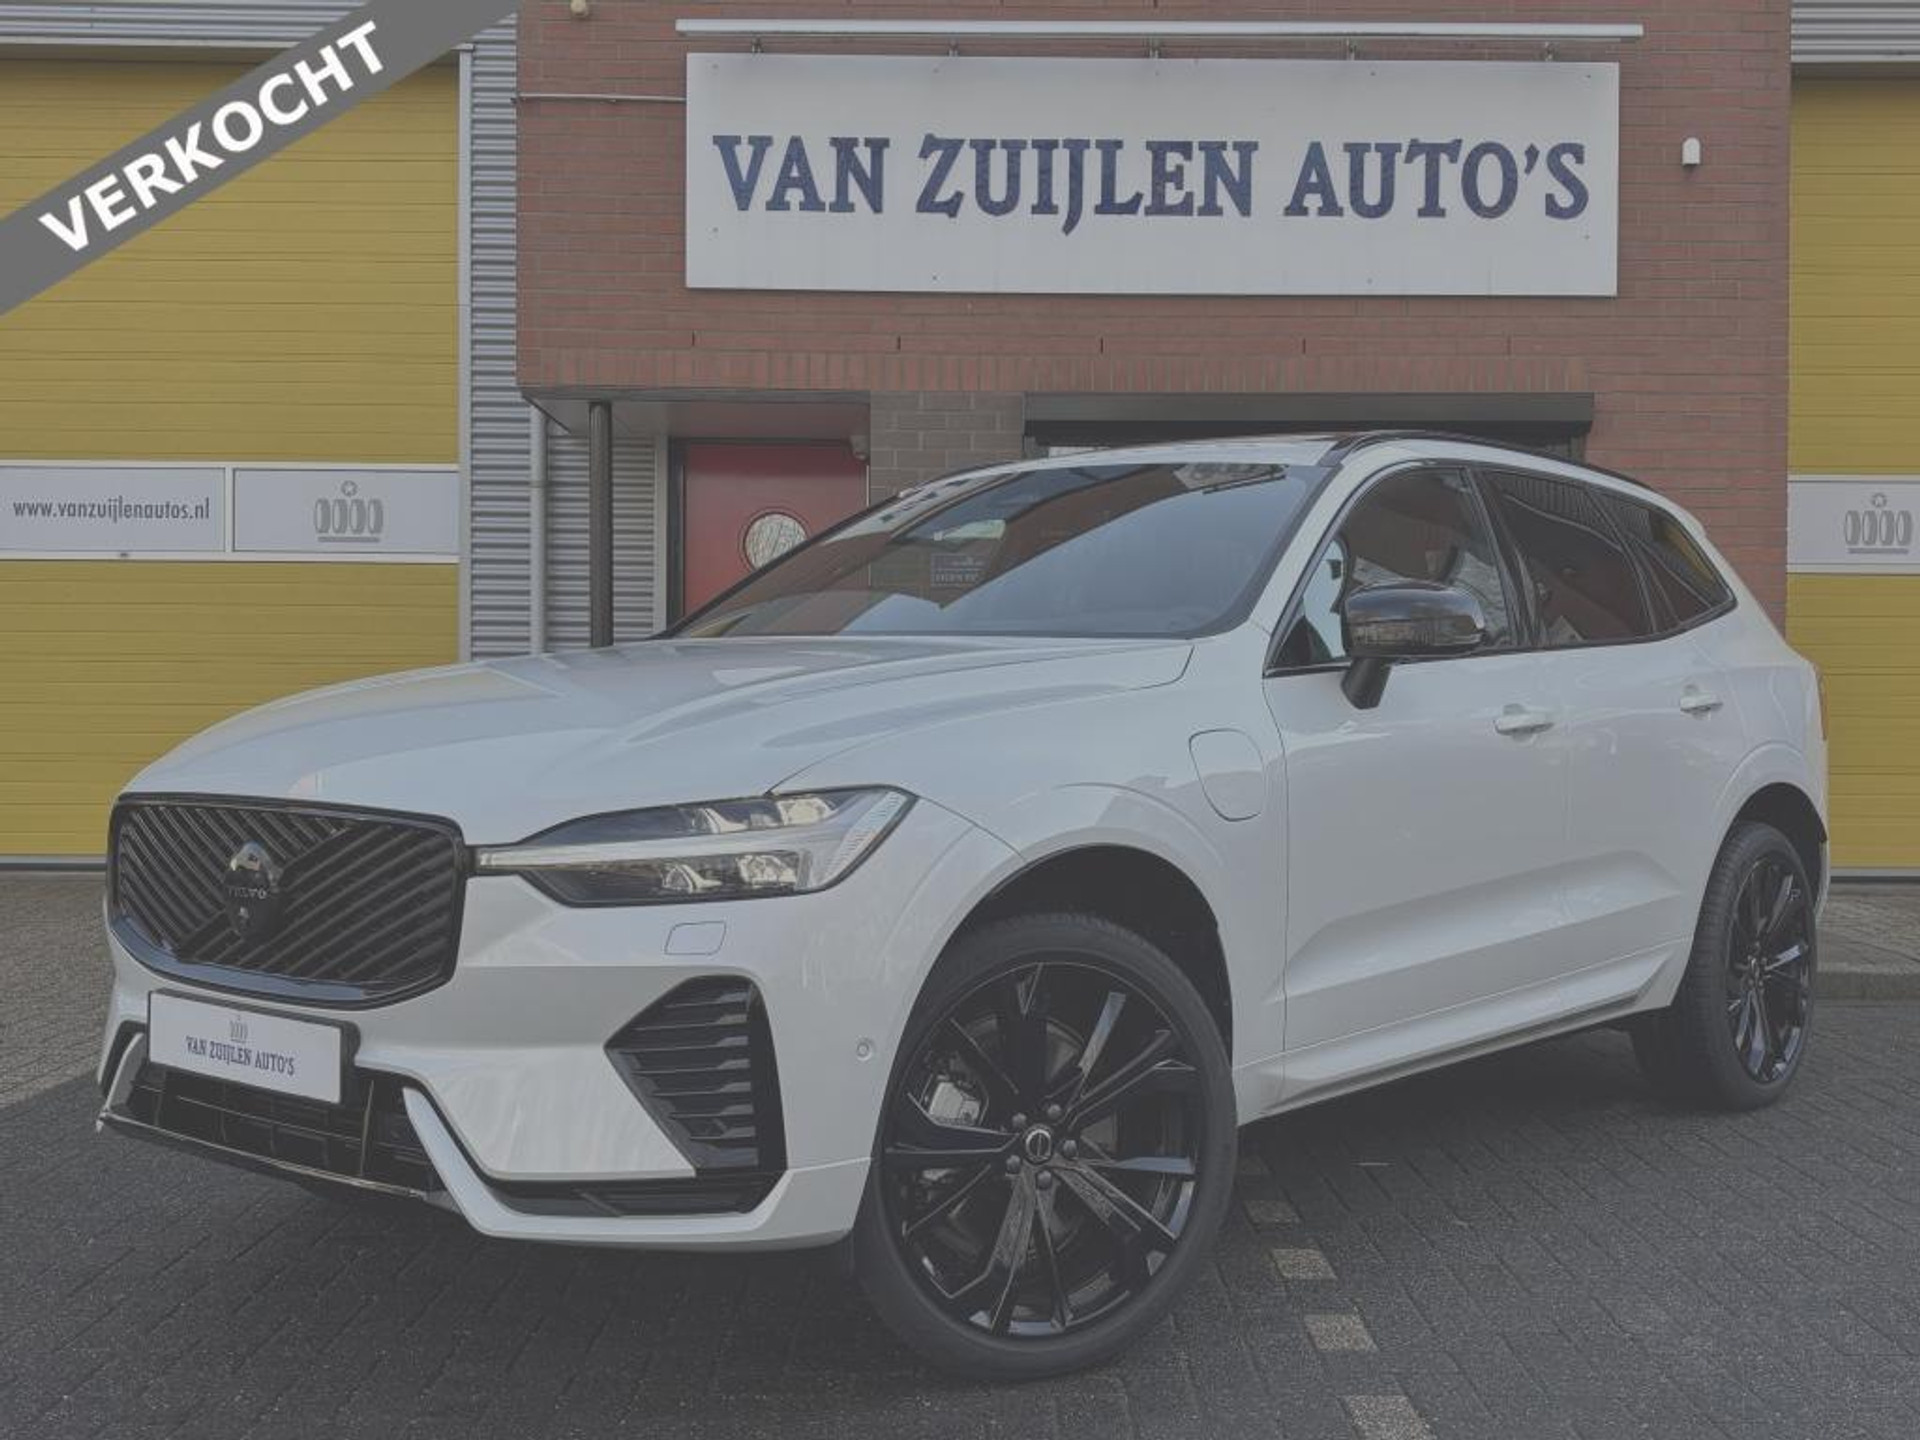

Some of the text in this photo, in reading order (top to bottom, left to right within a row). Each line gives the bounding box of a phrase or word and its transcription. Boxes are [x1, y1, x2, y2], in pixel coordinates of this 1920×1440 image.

[712, 133, 1590, 236] VAN ZUIJLEN AUTO'S
[13, 496, 210, 523] www.vanzuijlenautos.nl
[186, 1036, 295, 1076] VAN ZUIJLEN AUTO'S
